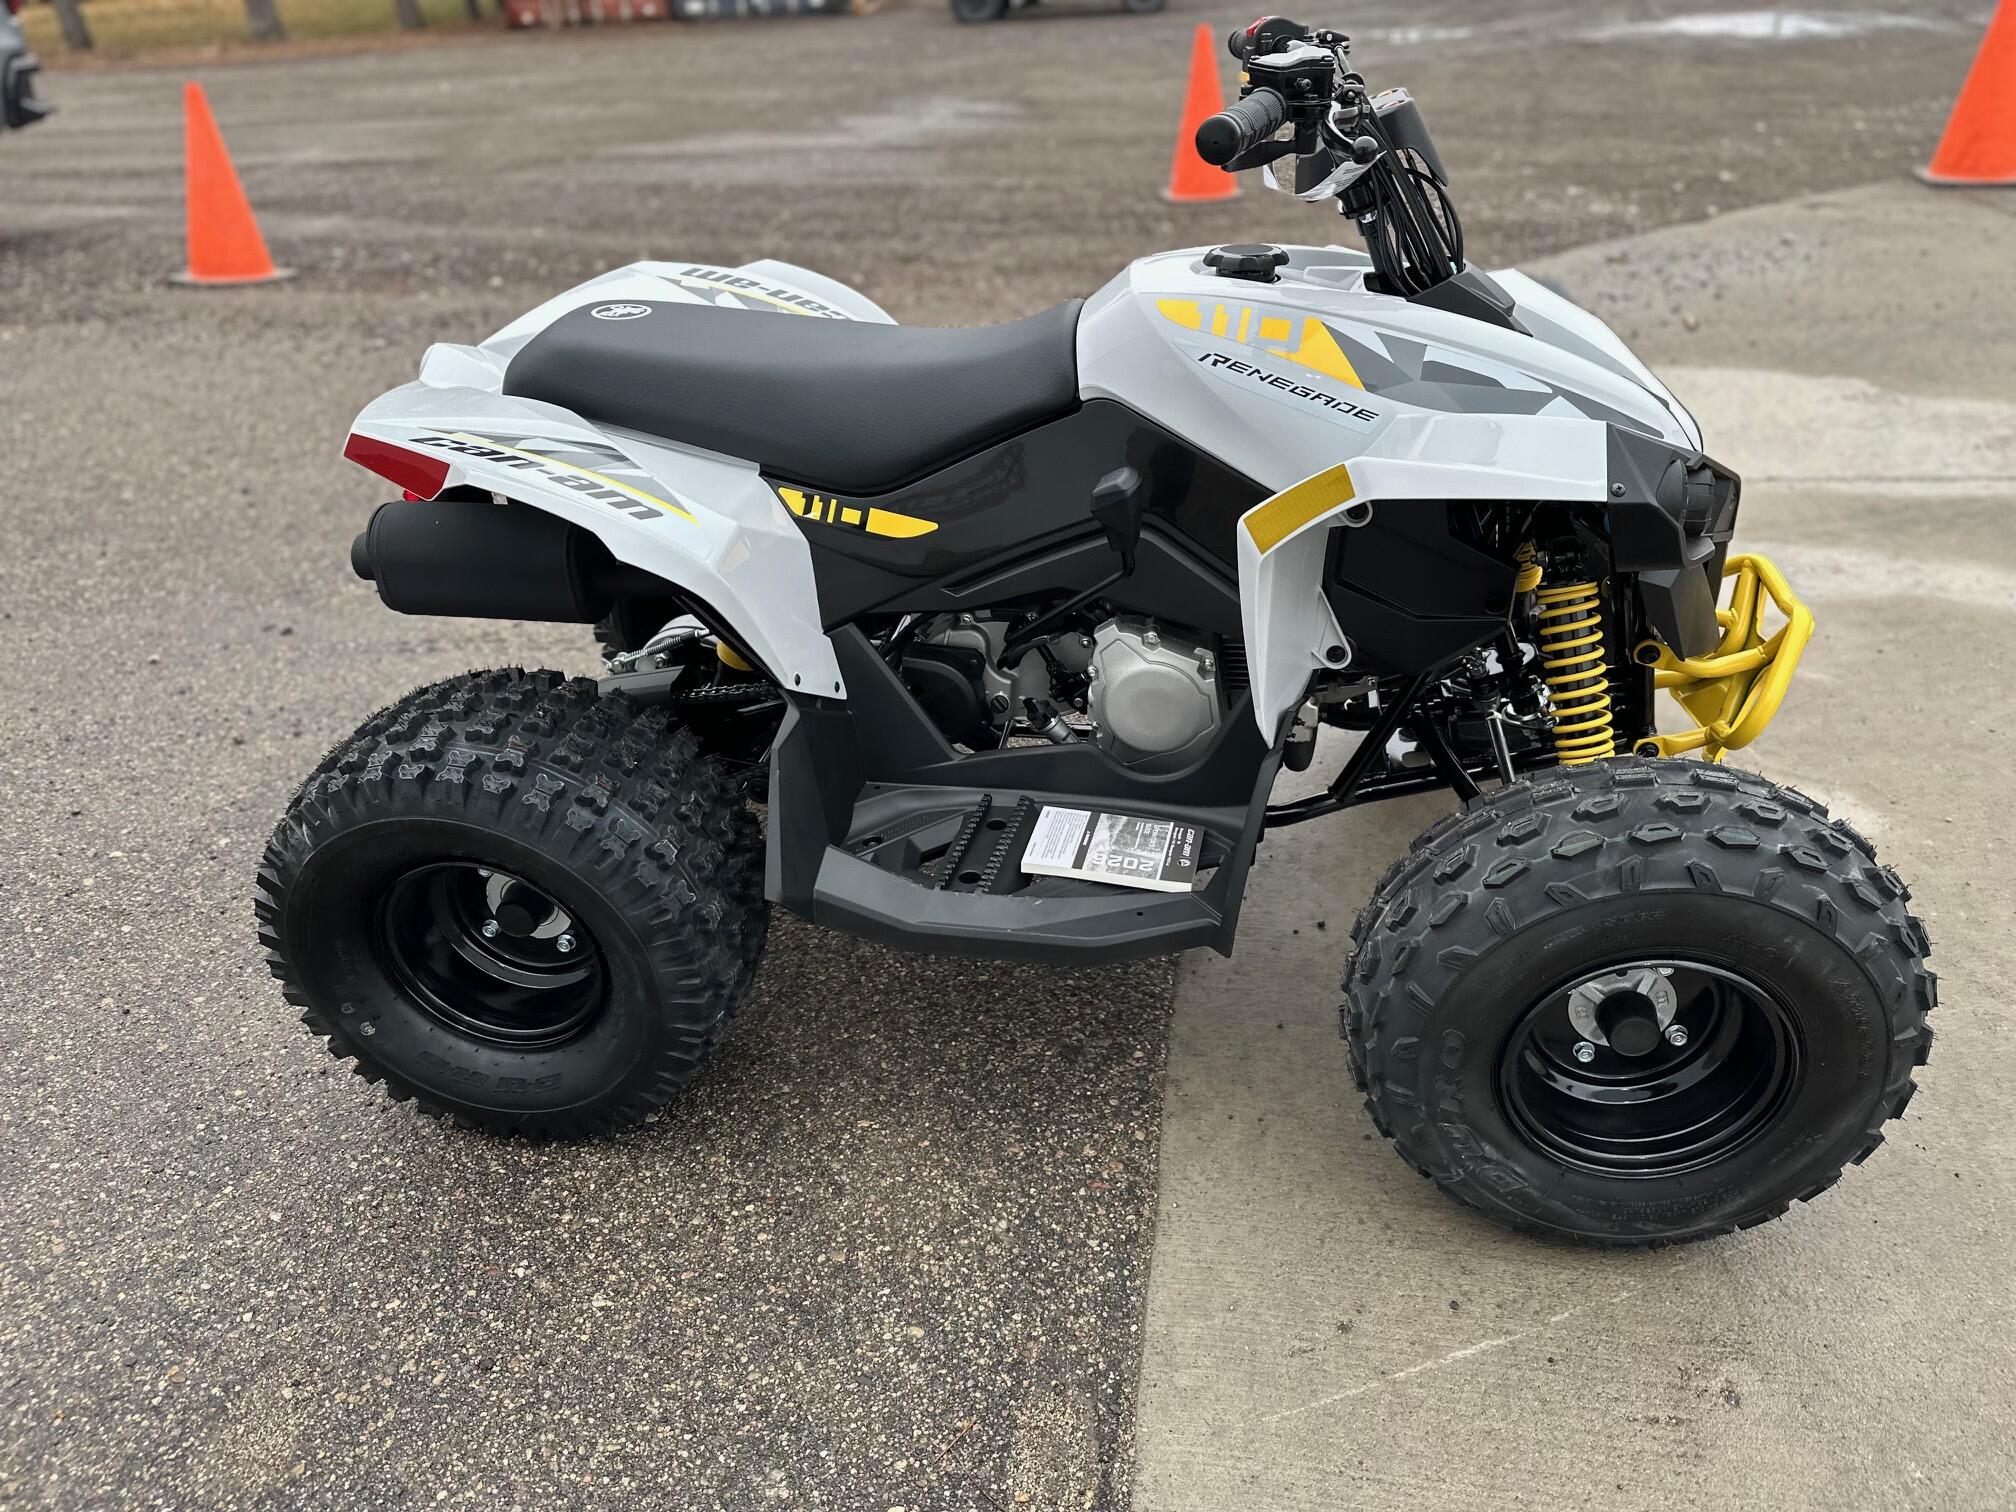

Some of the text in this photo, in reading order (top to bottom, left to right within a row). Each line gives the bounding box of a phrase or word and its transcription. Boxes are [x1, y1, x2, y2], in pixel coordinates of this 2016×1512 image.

[1198, 352, 1379, 422] RENEGADE
[408, 436, 664, 520] can-am
[1182, 828, 1195, 857] can-am
